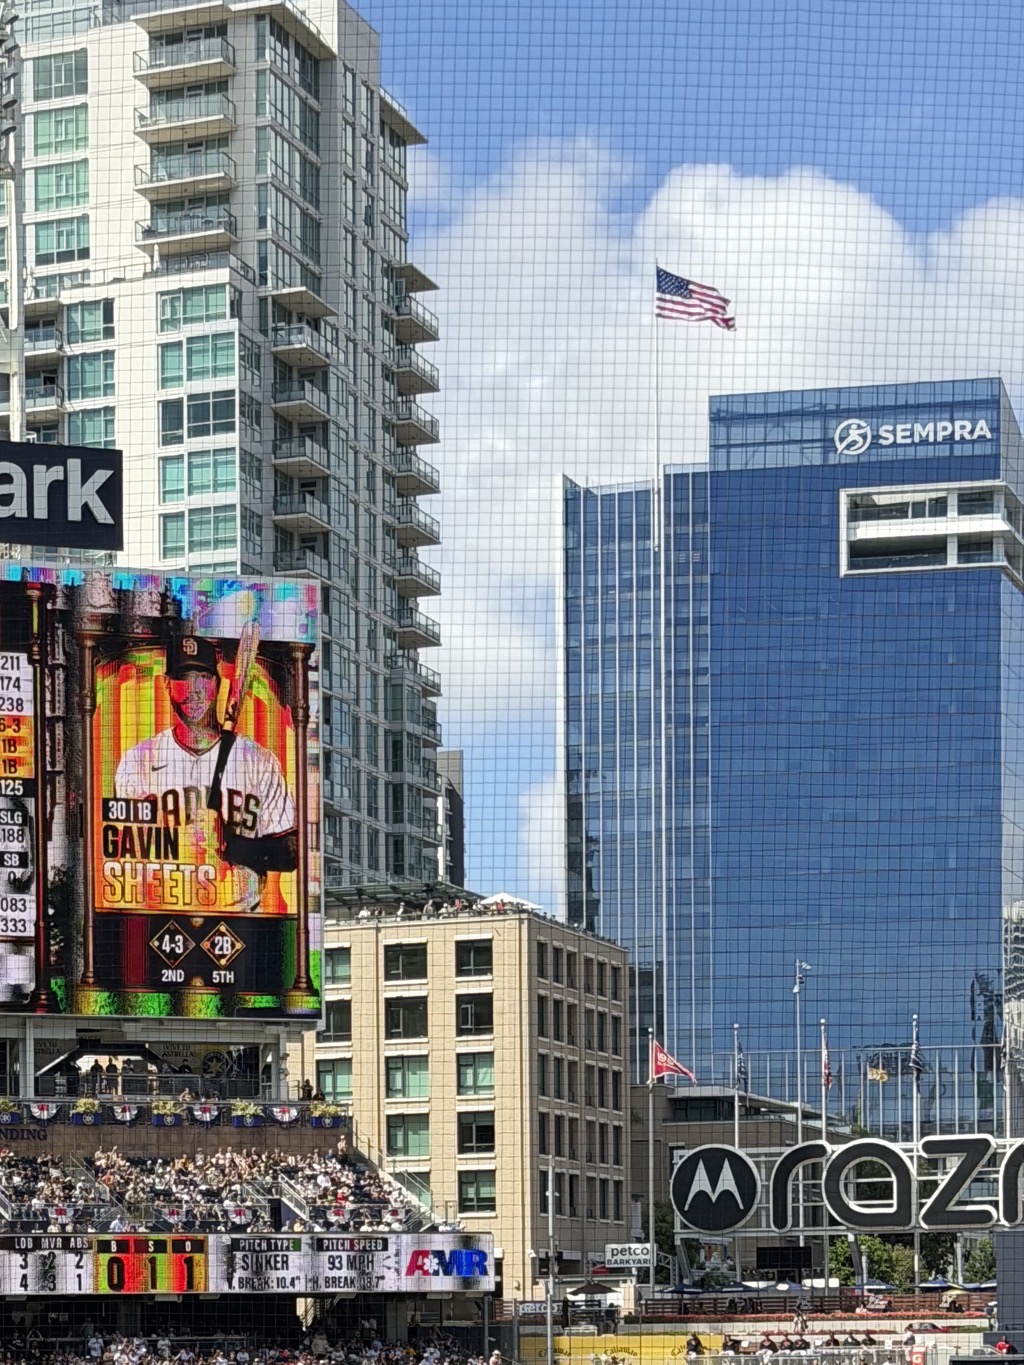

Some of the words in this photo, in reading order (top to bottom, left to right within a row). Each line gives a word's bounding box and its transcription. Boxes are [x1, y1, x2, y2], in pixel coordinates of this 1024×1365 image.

[878, 419, 992, 446] SEMPRA
[0, 811, 23, 824] SLG
[108, 801, 126, 820] 30
[137, 802, 152, 821] 1B
[103, 824, 180, 861] GAVIN
[4, 854, 20, 867] SB
[103, 861, 217, 906] SHEETS
[161, 935, 184, 954] 4-3
[214, 936, 232, 955] 2B
[161, 970, 185, 983] 2ND
[212, 970, 235, 984] 5TH
[14, 1237, 33, 1249] LOB
[41, 1237, 62, 1249] MVR
[69, 1237, 89, 1248] ABS
[240, 1240, 268, 1251] PITCH
[270, 1239, 294, 1251] TYPE
[323, 1239, 350, 1251] PITCH
[353, 1239, 383, 1251] SPEED
[610, 1246, 650, 1259] petco
[241, 1254, 290, 1271] SINKER
[327, 1254, 343, 1271] 93
[347, 1254, 374, 1271] MPH
[405, 1249, 490, 1277] AMR
